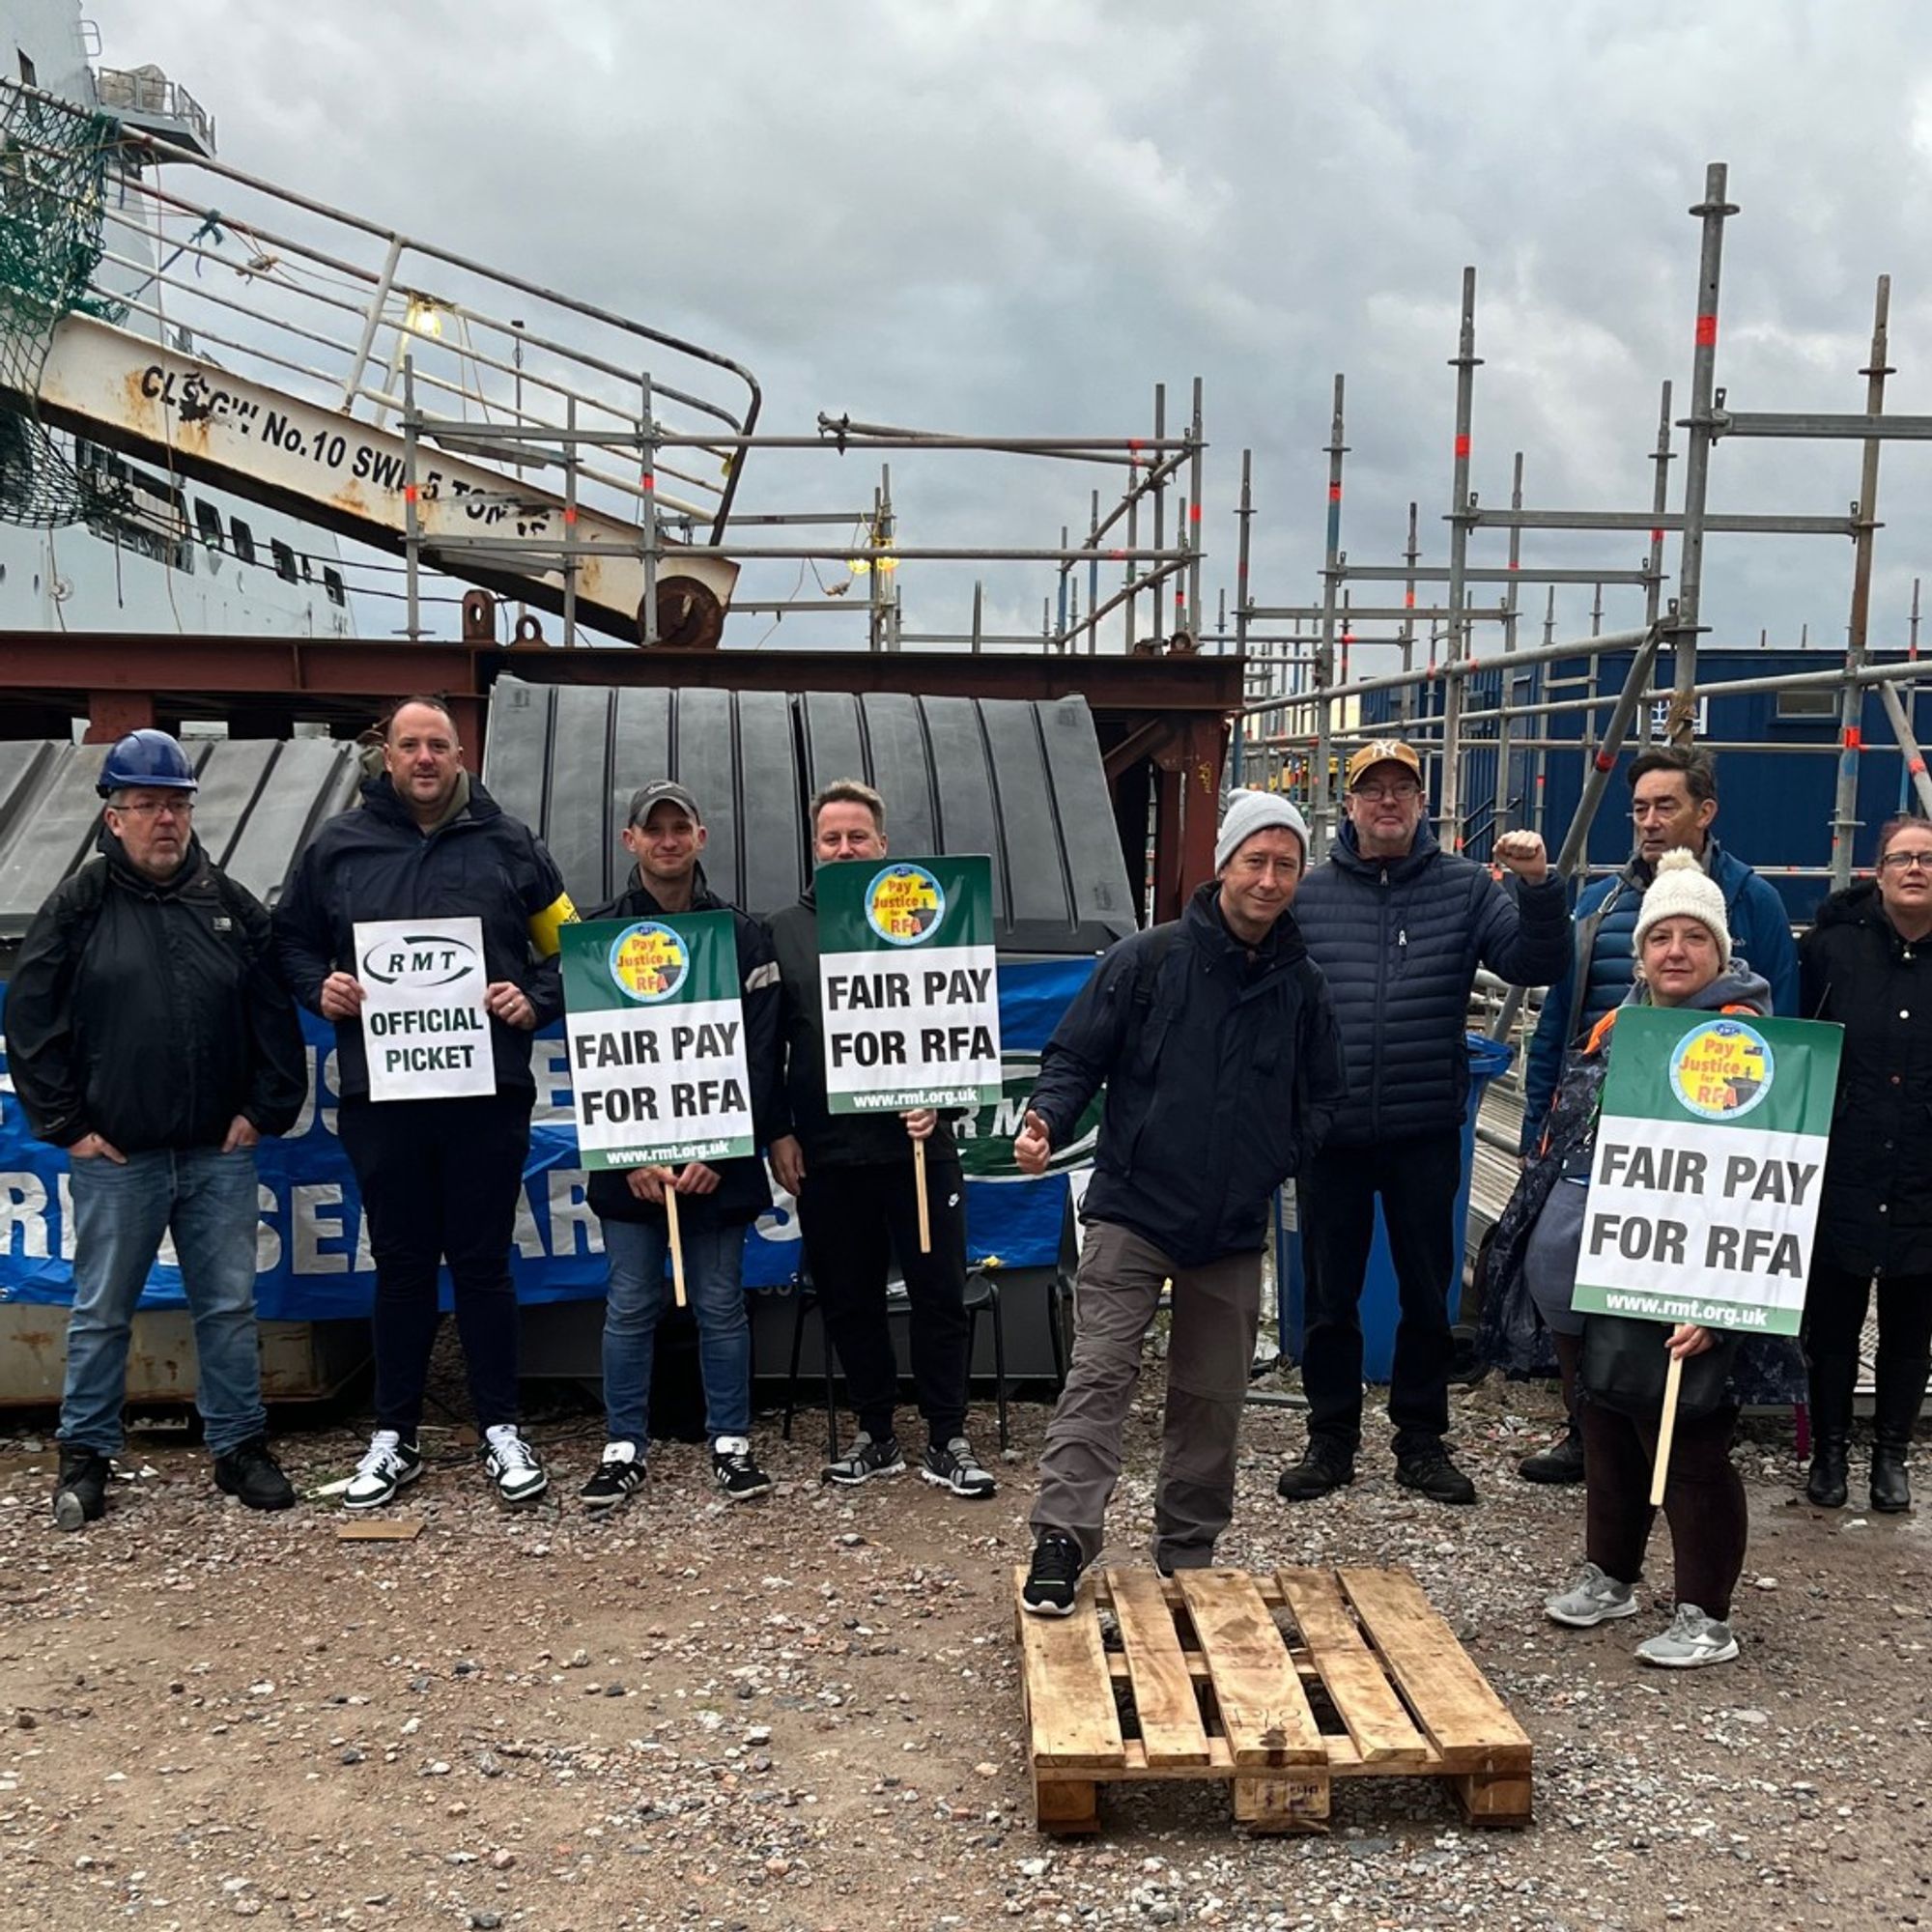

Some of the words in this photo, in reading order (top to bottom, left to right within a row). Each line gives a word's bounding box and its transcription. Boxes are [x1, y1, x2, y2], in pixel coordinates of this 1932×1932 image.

[262, 412, 347, 469] No.10
[422, 471, 442, 500] 5
[888, 880, 912, 895] Pay
[873, 895, 919, 910] Justice
[891, 917, 923, 933] RFA
[632, 939, 656, 952] Pay
[388, 951, 456, 973] RMT
[617, 954, 664, 968] Justice
[637, 975, 668, 991] RFA
[828, 973, 911, 1011] FAIR
[923, 968, 992, 1006] PAY
[370, 1008, 484, 1037] OFFICIAL
[575, 1029, 661, 1069] FAIR
[671, 1021, 740, 1061] PAY
[831, 1030, 907, 1067] FOR
[921, 1025, 997, 1063] RFA
[1703, 1038, 1735, 1058] Pay
[385, 1044, 474, 1072] PICKET
[1679, 1055, 1741, 1074] Justice
[582, 1086, 659, 1125] FOR
[671, 1078, 748, 1118] RFA
[853, 1088, 978, 1108] www.rmt.org.uk
[1697, 1086, 1738, 1106] RFA
[606, 1140, 729, 1165] www.rmt.org.uk
[1599, 1143, 1708, 1195] FAIR
[1722, 1155, 1819, 1206] PAY
[1589, 1212, 1689, 1264] FOR
[1705, 1225, 1803, 1279] RFA
[1605, 1293, 1768, 1327] www.rmt.org.uk
